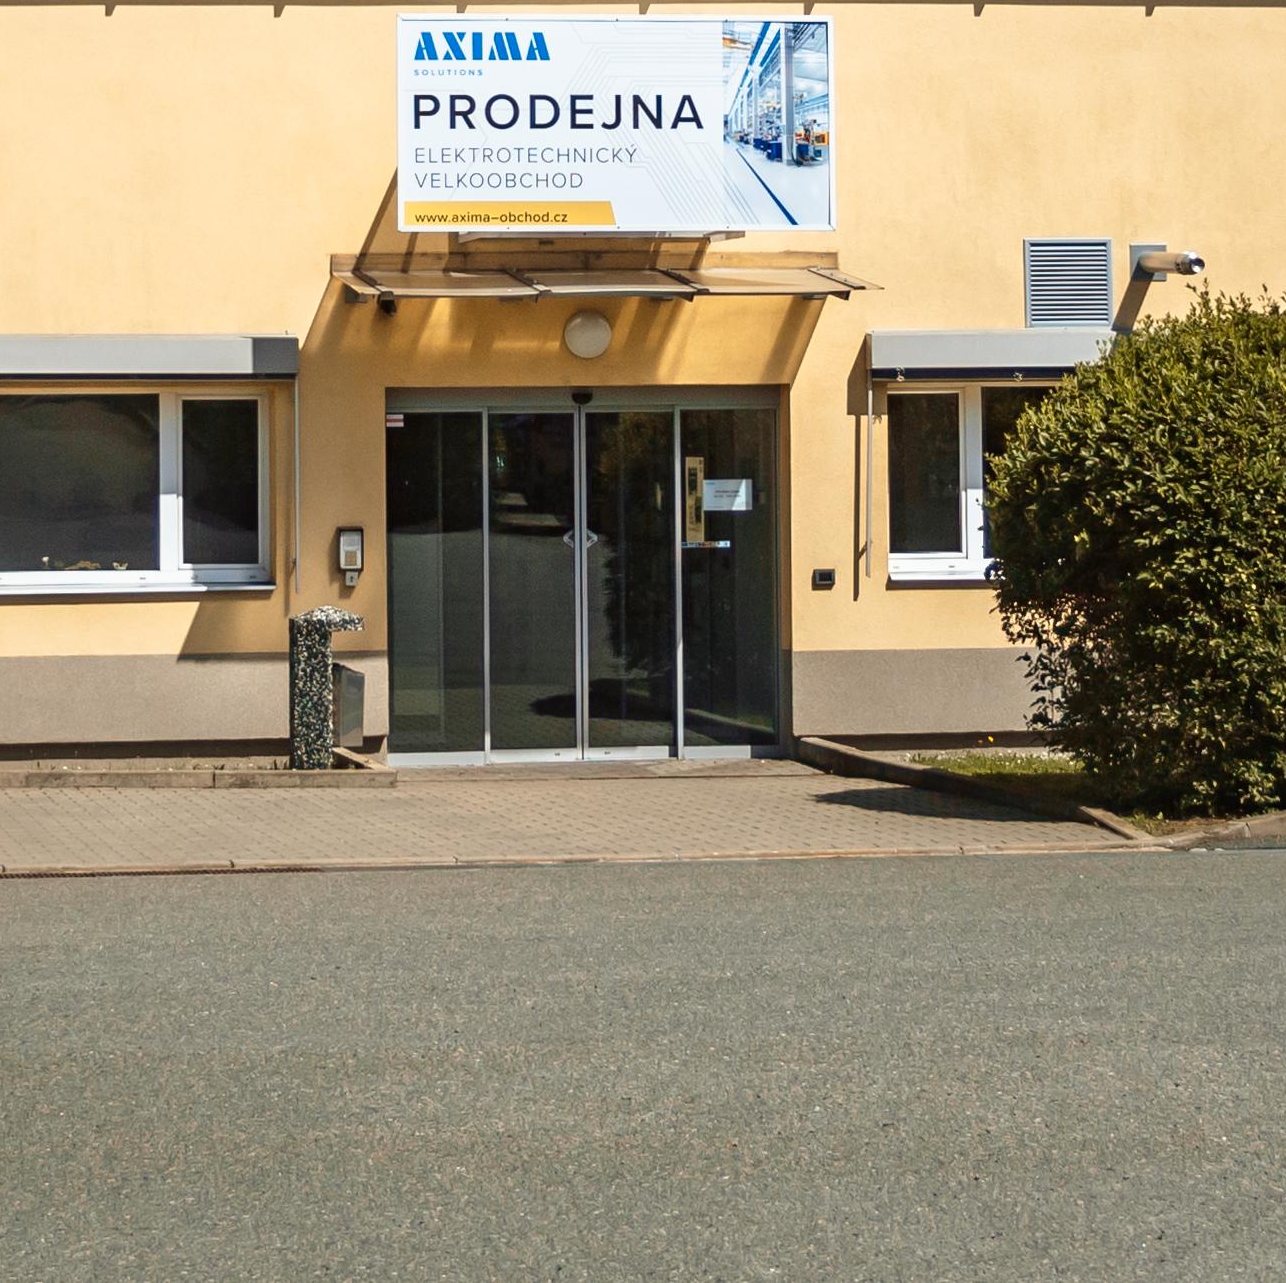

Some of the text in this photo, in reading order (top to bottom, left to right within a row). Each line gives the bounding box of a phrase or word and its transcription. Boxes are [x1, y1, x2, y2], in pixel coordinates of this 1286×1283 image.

[415, 32, 551, 61] AXIMA
[413, 94, 704, 130] PRODEJNA
[415, 144, 638, 164] ELEKTROTECHNICKÝ
[414, 173, 583, 189] VELKOOBCHOD
[415, 211, 568, 223] www.axima-obchod.cz
